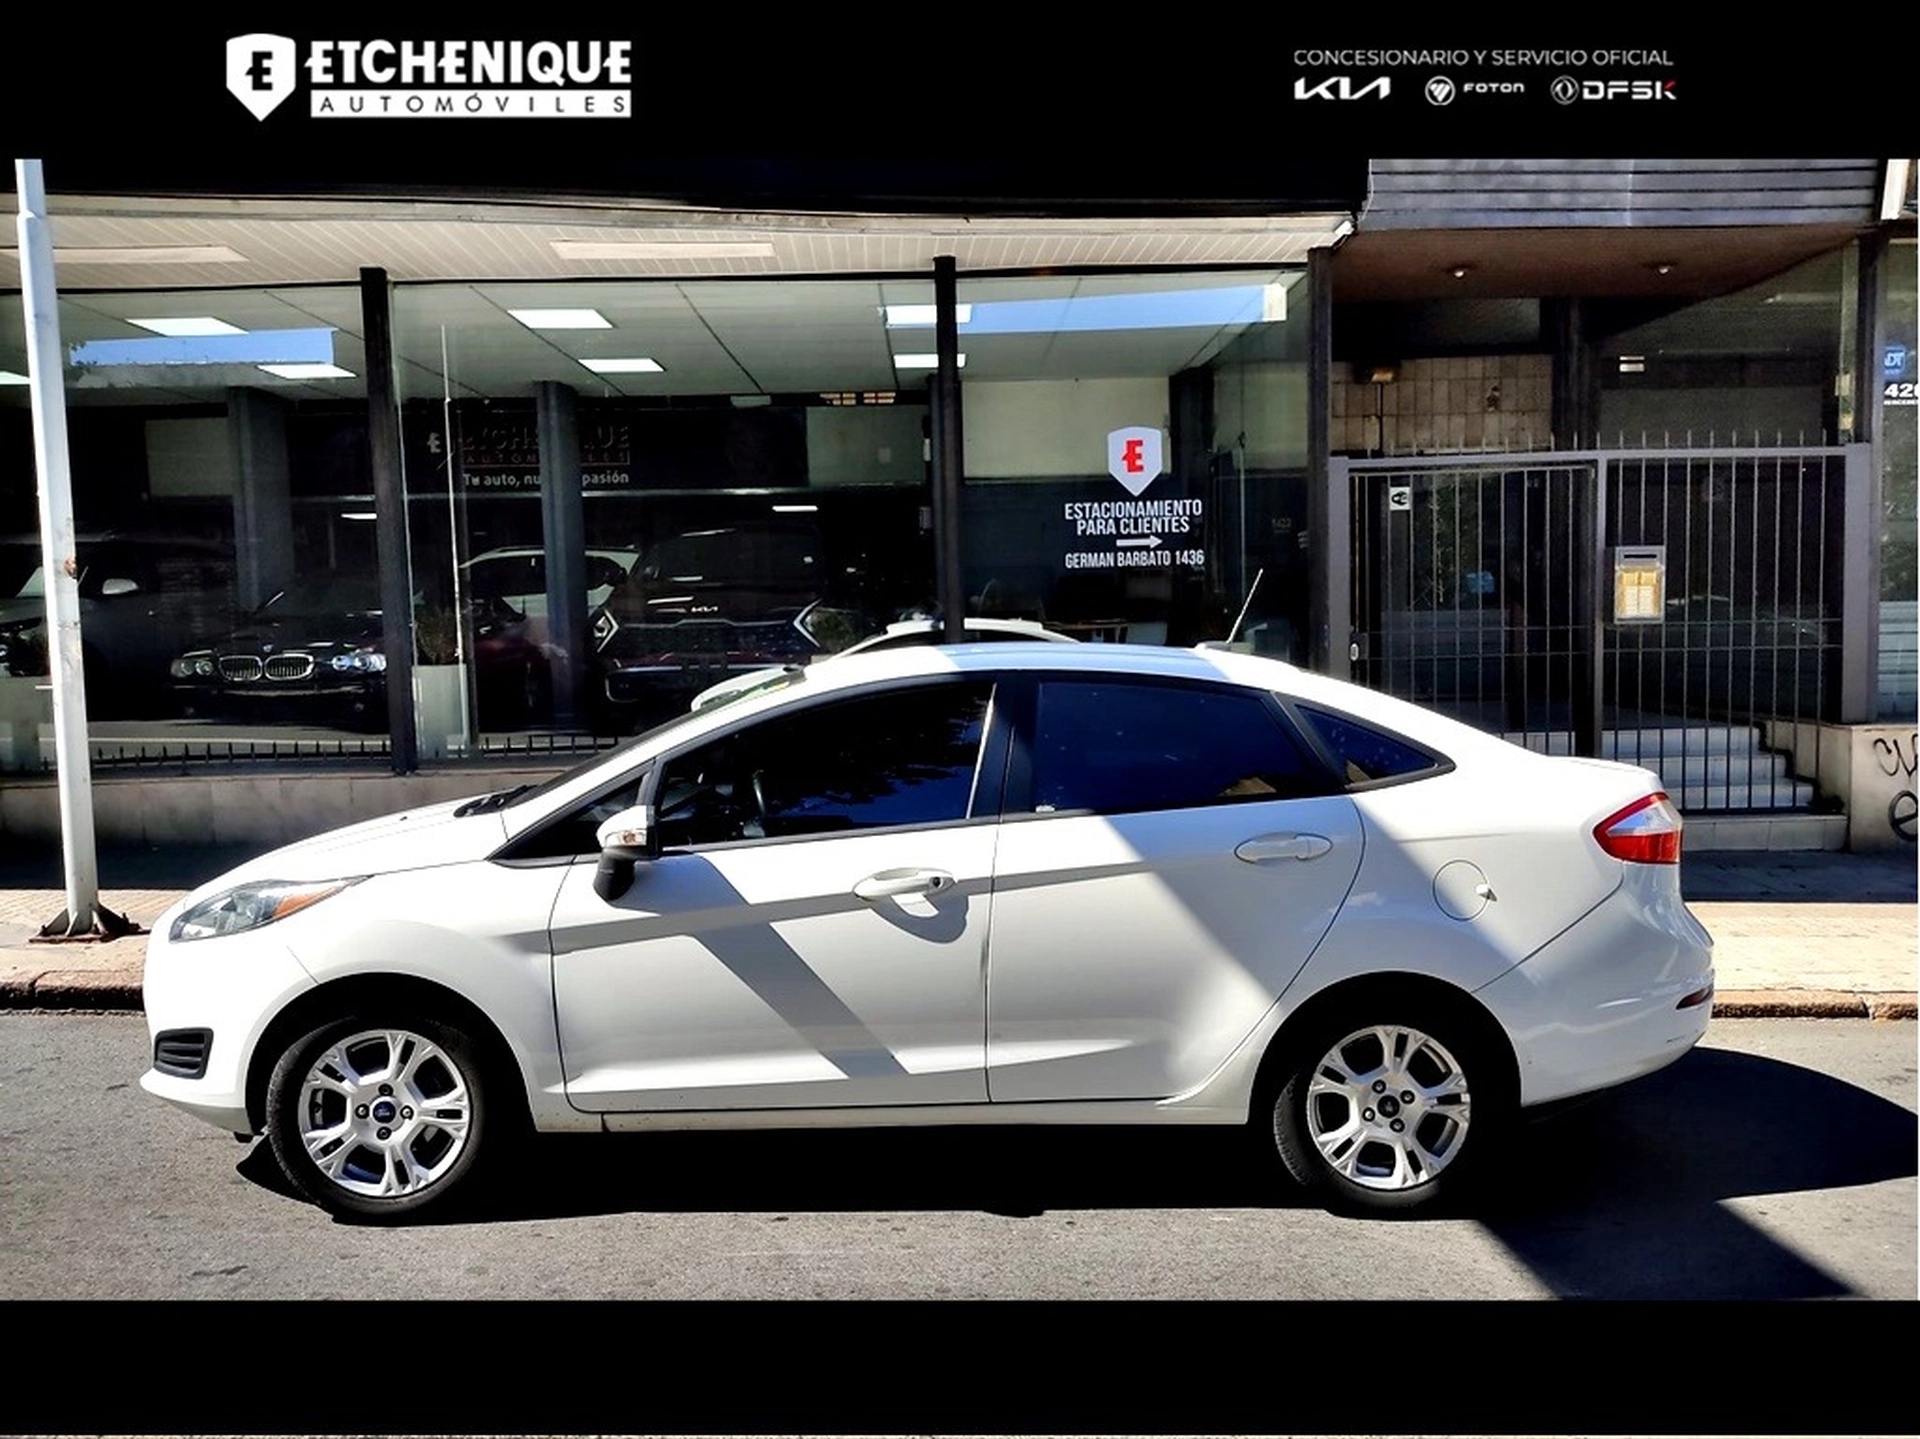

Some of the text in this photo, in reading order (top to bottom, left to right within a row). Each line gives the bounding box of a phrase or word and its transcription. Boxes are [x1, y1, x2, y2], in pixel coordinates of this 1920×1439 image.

[483, 472, 520, 488] auto,
[581, 470, 629, 486] pasión
[1064, 499, 1203, 520] ESTACIONAMIENTO
[1076, 515, 1190, 536] PARA CLIENTES
[1065, 549, 1205, 569] GERMAN BARBATO 1436
